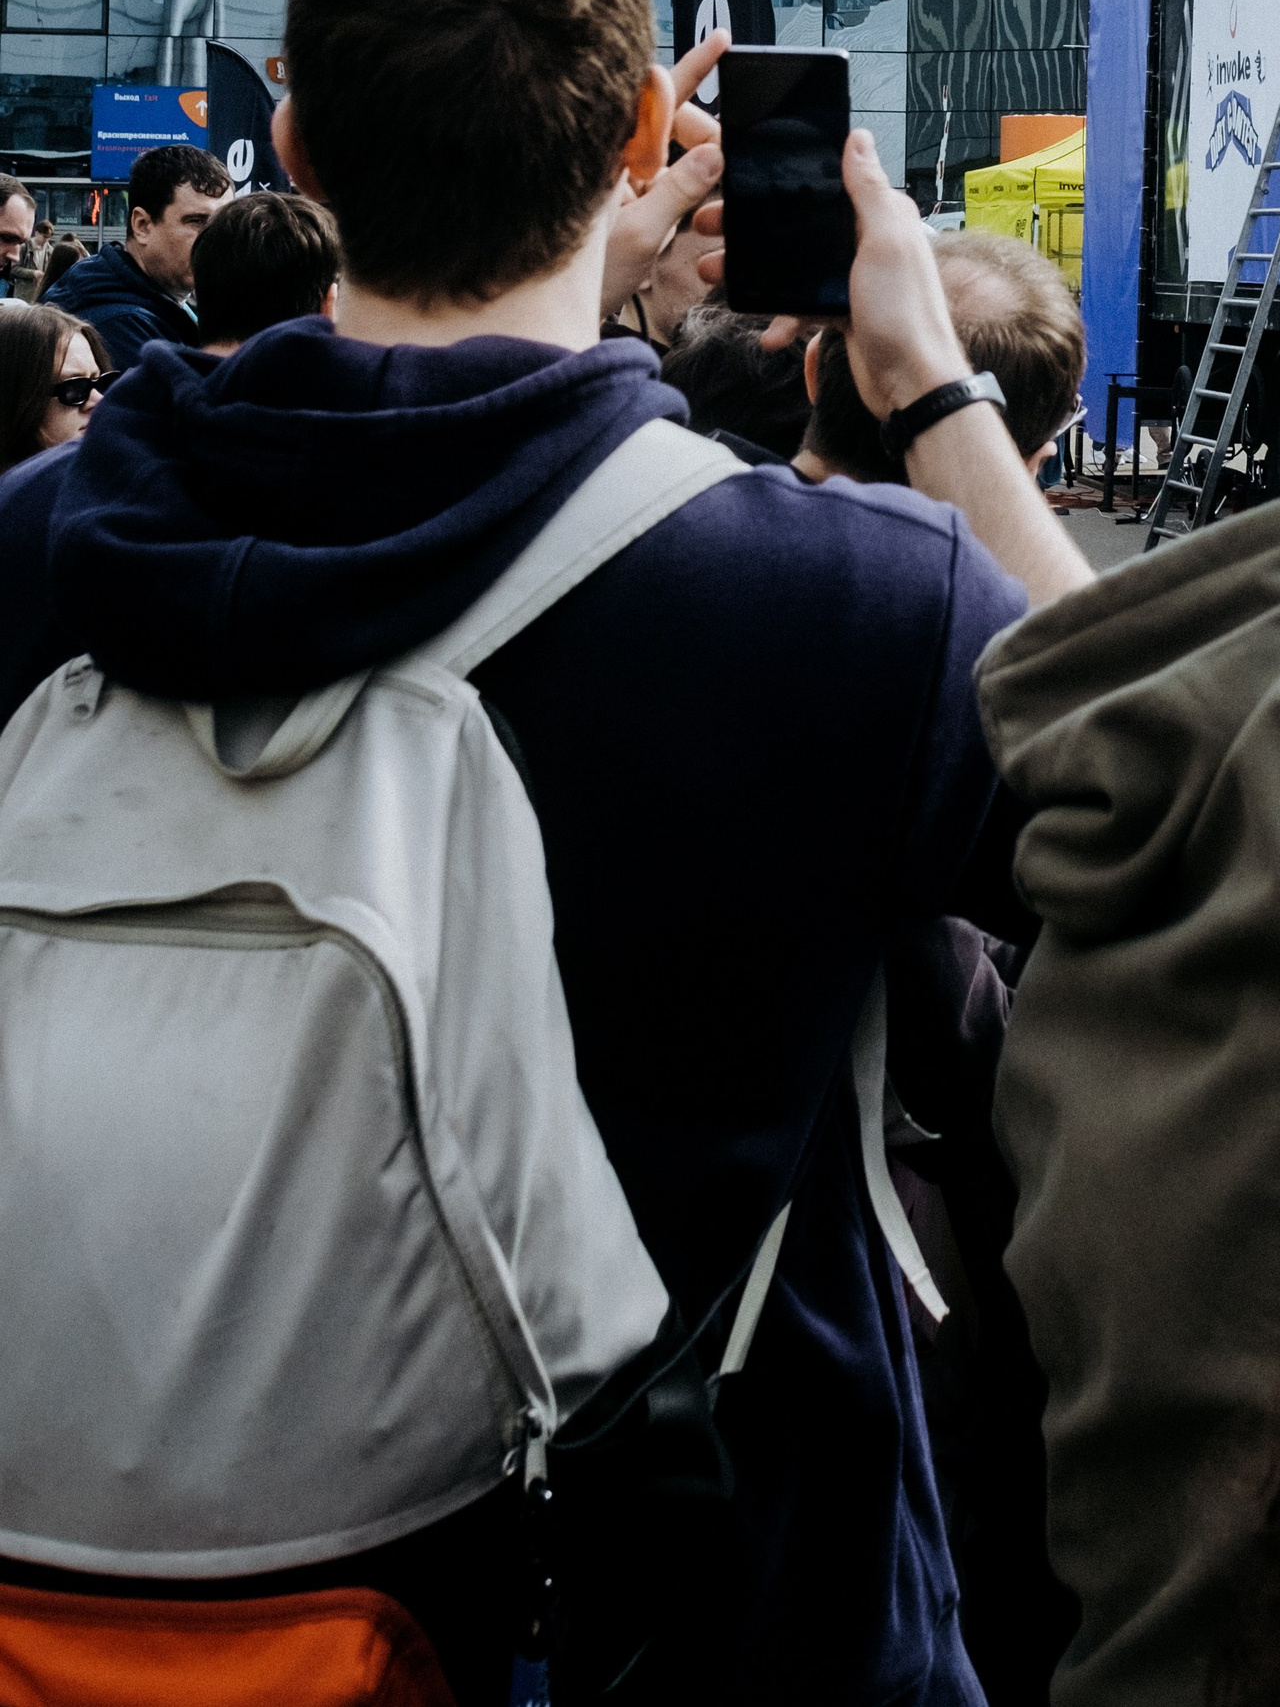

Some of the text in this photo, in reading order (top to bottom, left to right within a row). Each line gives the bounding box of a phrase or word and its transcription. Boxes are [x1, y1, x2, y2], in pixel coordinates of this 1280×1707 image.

[1216, 50, 1251, 85] invoke
[114, 93, 140, 102] Выход
[172, 132, 190, 141] наб.
